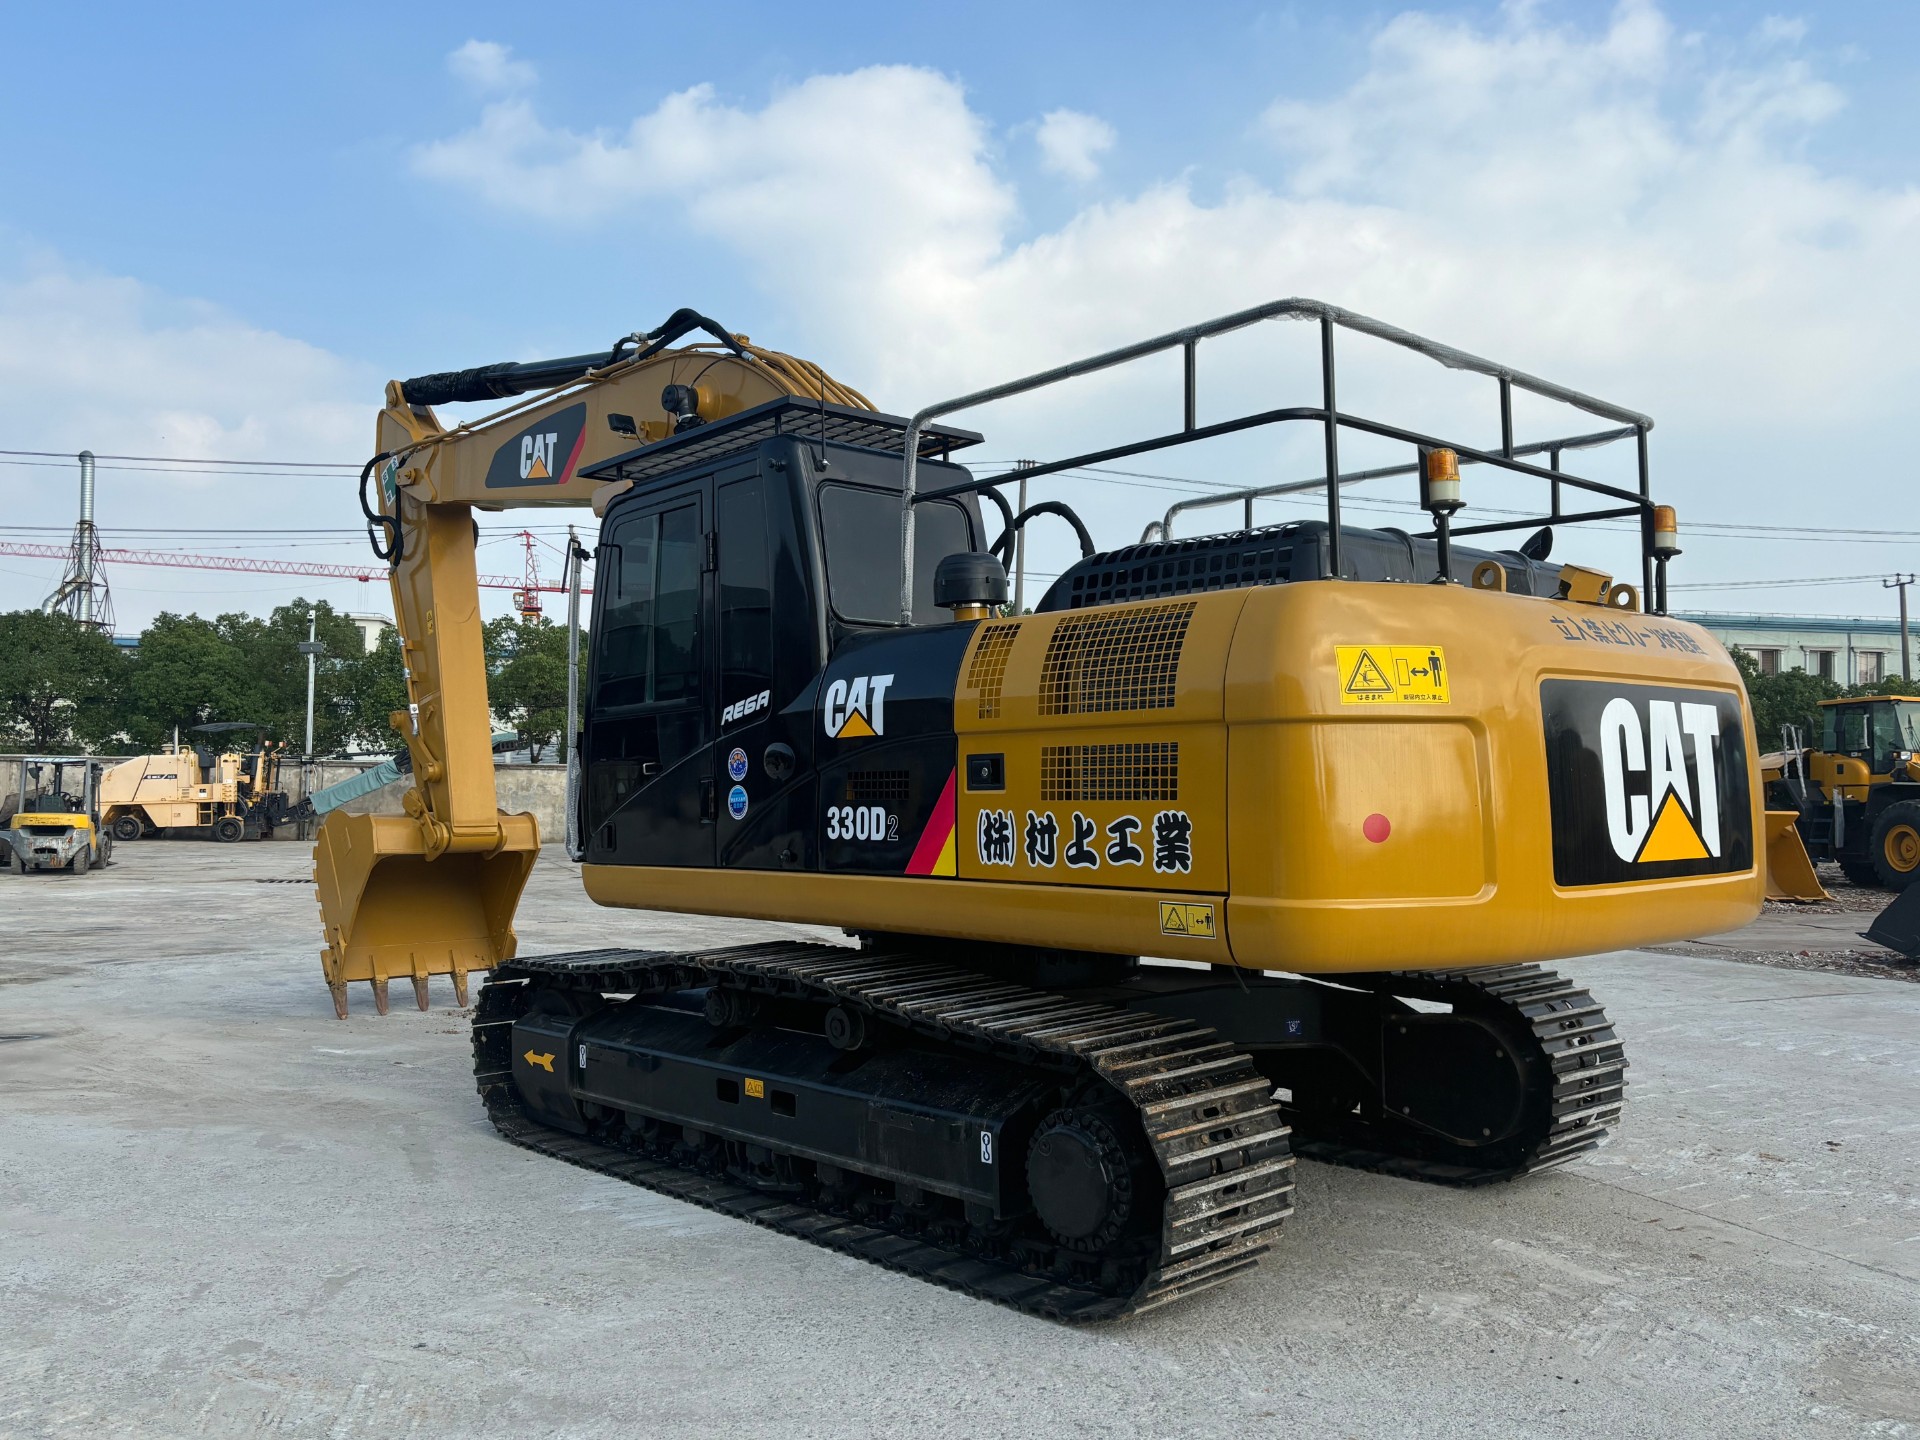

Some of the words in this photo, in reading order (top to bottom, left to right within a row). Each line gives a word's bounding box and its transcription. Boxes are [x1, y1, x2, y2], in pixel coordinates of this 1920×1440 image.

[520, 432, 558, 479] CAT
[720, 689, 771, 726] REGA
[824, 674, 895, 738] CAT
[1600, 697, 1721, 863] CAT
